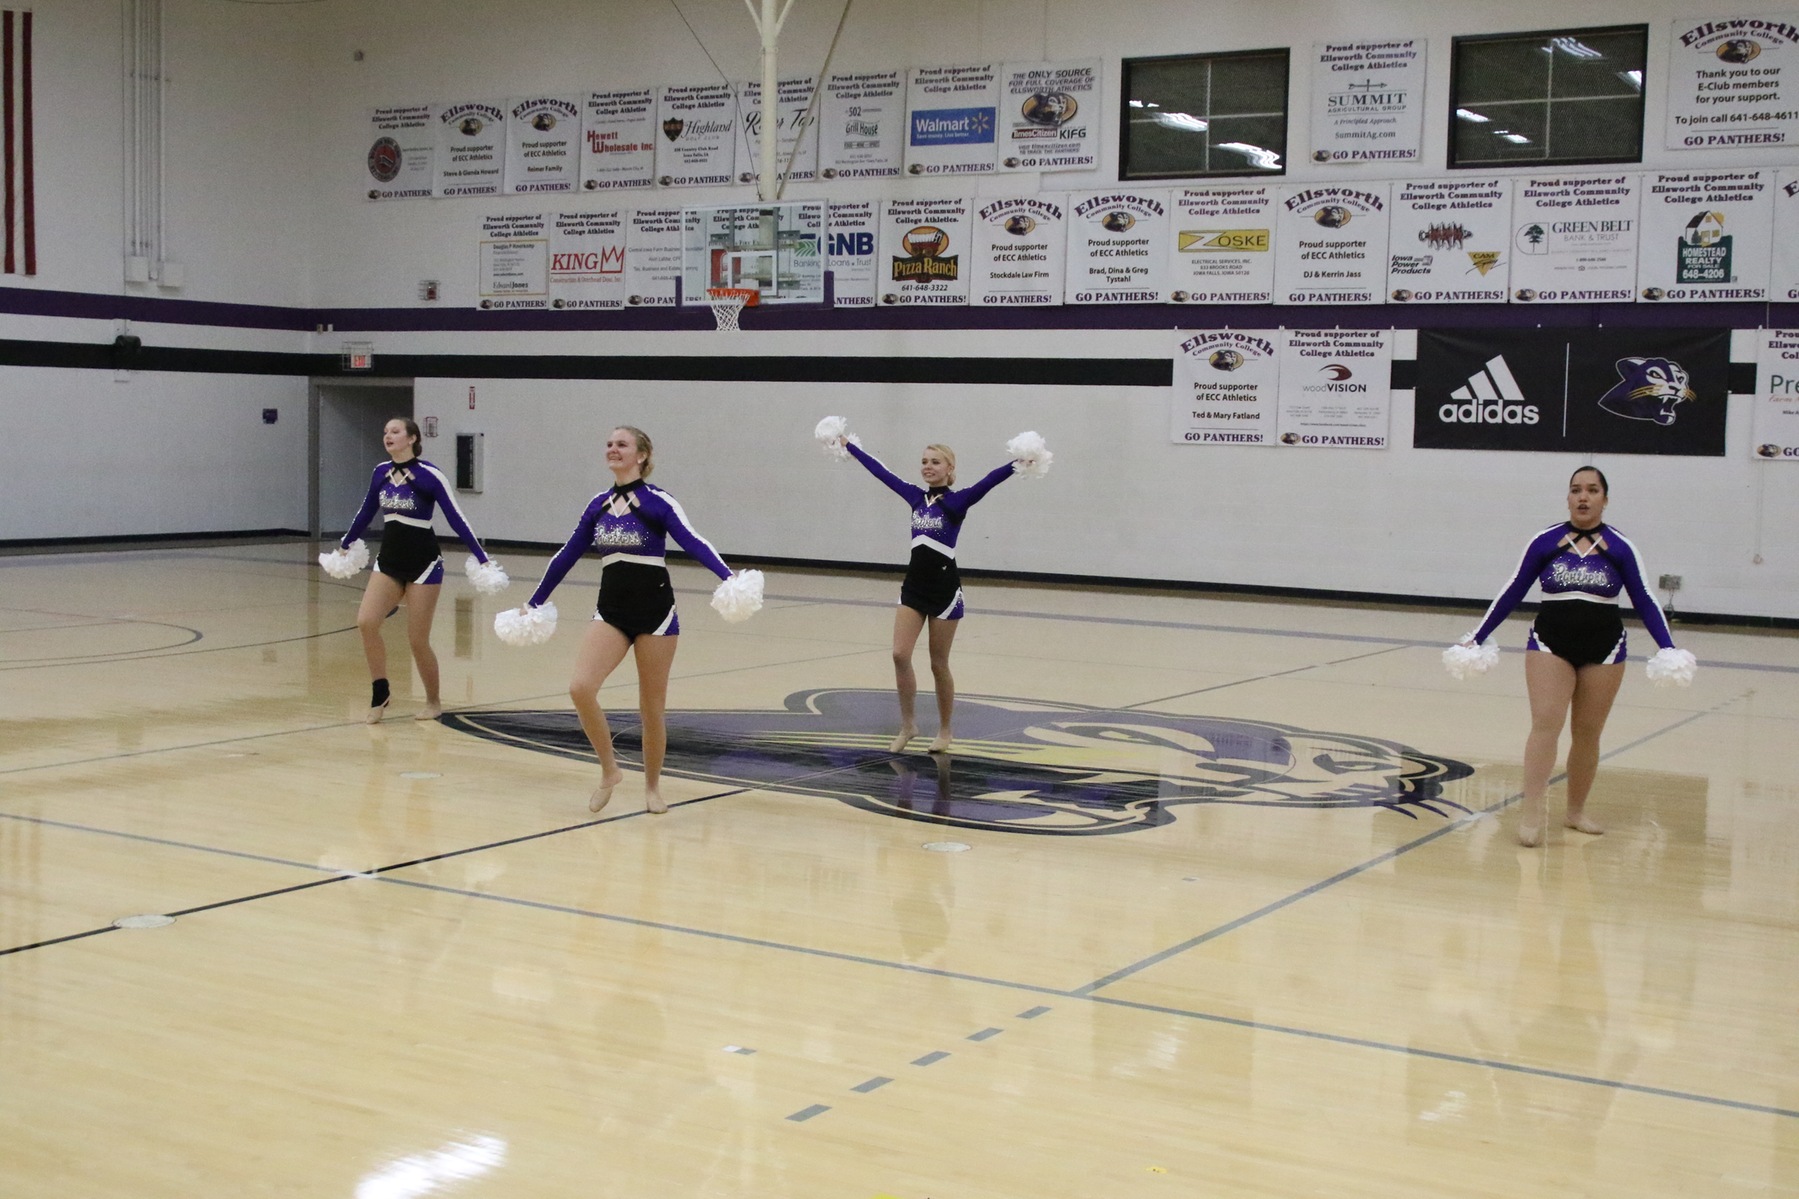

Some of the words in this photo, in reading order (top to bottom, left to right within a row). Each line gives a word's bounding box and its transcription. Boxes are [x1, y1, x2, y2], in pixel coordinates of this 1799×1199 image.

[1680, 20, 1799, 47] Ellsworth
[1695, 30, 1747, 49] Community
[1751, 30, 1784, 44] College
[1055, 68, 1091, 77] SOURCE
[1696, 70, 1727, 78] Thank
[1729, 70, 1747, 79] you
[1698, 82, 1730, 91] E-Club
[1733, 80, 1779, 89] members
[1328, 93, 1407, 107] SUMMIT
[1696, 95, 1710, 103] for
[1713, 95, 1735, 104] your
[1738, 93, 1780, 103] support.
[512, 99, 578, 118] Ellsworth
[849, 106, 861, 117] 502
[1675, 116, 1687, 124] To
[1689, 115, 1708, 125] join
[1711, 114, 1727, 123] call
[1730, 111, 1798, 122] 641-648-4611
[681, 120, 733, 138] Highland
[846, 123, 859, 133] Grill
[860, 123, 878, 135] House
[916, 117, 969, 132] Walmart
[587, 130, 618, 142] Hewett
[1060, 129, 1086, 139] KIFG
[1335, 131, 1396, 139] SummitAg.com
[1684, 136, 1703, 146] GO
[1708, 133, 1785, 146] PANTHERS!
[593, 141, 637, 153] Wholesale
[1333, 151, 1348, 159] GO
[1352, 149, 1416, 159] PANTHERS!
[1039, 156, 1093, 166] PANTHERS!
[926, 165, 940, 173] GO
[943, 163, 994, 172] PANTHERS!
[1693, 174, 1745, 182] supporter
[1652, 185, 1700, 193] Ellsworth
[1704, 183, 1764, 191] Community
[1284, 188, 1383, 211] Ellsworth
[1664, 196, 1703, 204] College
[1706, 194, 1753, 202] Athletics
[979, 199, 1062, 220] Ellsworth
[1074, 195, 1164, 217] Ellsworth
[1112, 239, 1149, 247] supporter
[1179, 232, 1266, 250] ZOSKE
[1326, 241, 1366, 249] supporter
[1014, 244, 1048, 252] supporter
[1683, 247, 1726, 257] HOMESTEAD
[551, 253, 598, 270] KING
[894, 262, 921, 277] Pizza
[924, 258, 956, 276] Ranch
[1683, 269, 1724, 279] 648-4206
[1106, 276, 1131, 284] Tystahl
[914, 295, 966, 303] PANTHERS!
[1001, 295, 1052, 303] PANTHERS!
[1076, 293, 1092, 301] GO
[1096, 292, 1158, 301] PANTHERS!
[1191, 293, 1207, 301] GO
[1210, 292, 1269, 300] PANTHERS!
[1309, 293, 1371, 301] PANTHERS!
[1415, 292, 1431, 300] GO
[1436, 291, 1503, 300] PANTHERS!
[1539, 291, 1557, 299] GO
[1561, 290, 1631, 299] PANTHERS!
[1667, 290, 1685, 299] GO
[1690, 289, 1765, 298] PANTHERS!
[1180, 333, 1274, 356] Ellsworth
[1333, 340, 1384, 348] Community
[1300, 350, 1332, 358] College
[1194, 382, 1217, 390] Proud
[1303, 384, 1366, 392] woodVISION
[1213, 412, 1231, 420] Mary
[1439, 399, 1539, 425] adidas
[1185, 433, 1200, 441] GO
[1204, 433, 1263, 442] PANTHERS!
[1322, 436, 1384, 445] PANTHERS!
